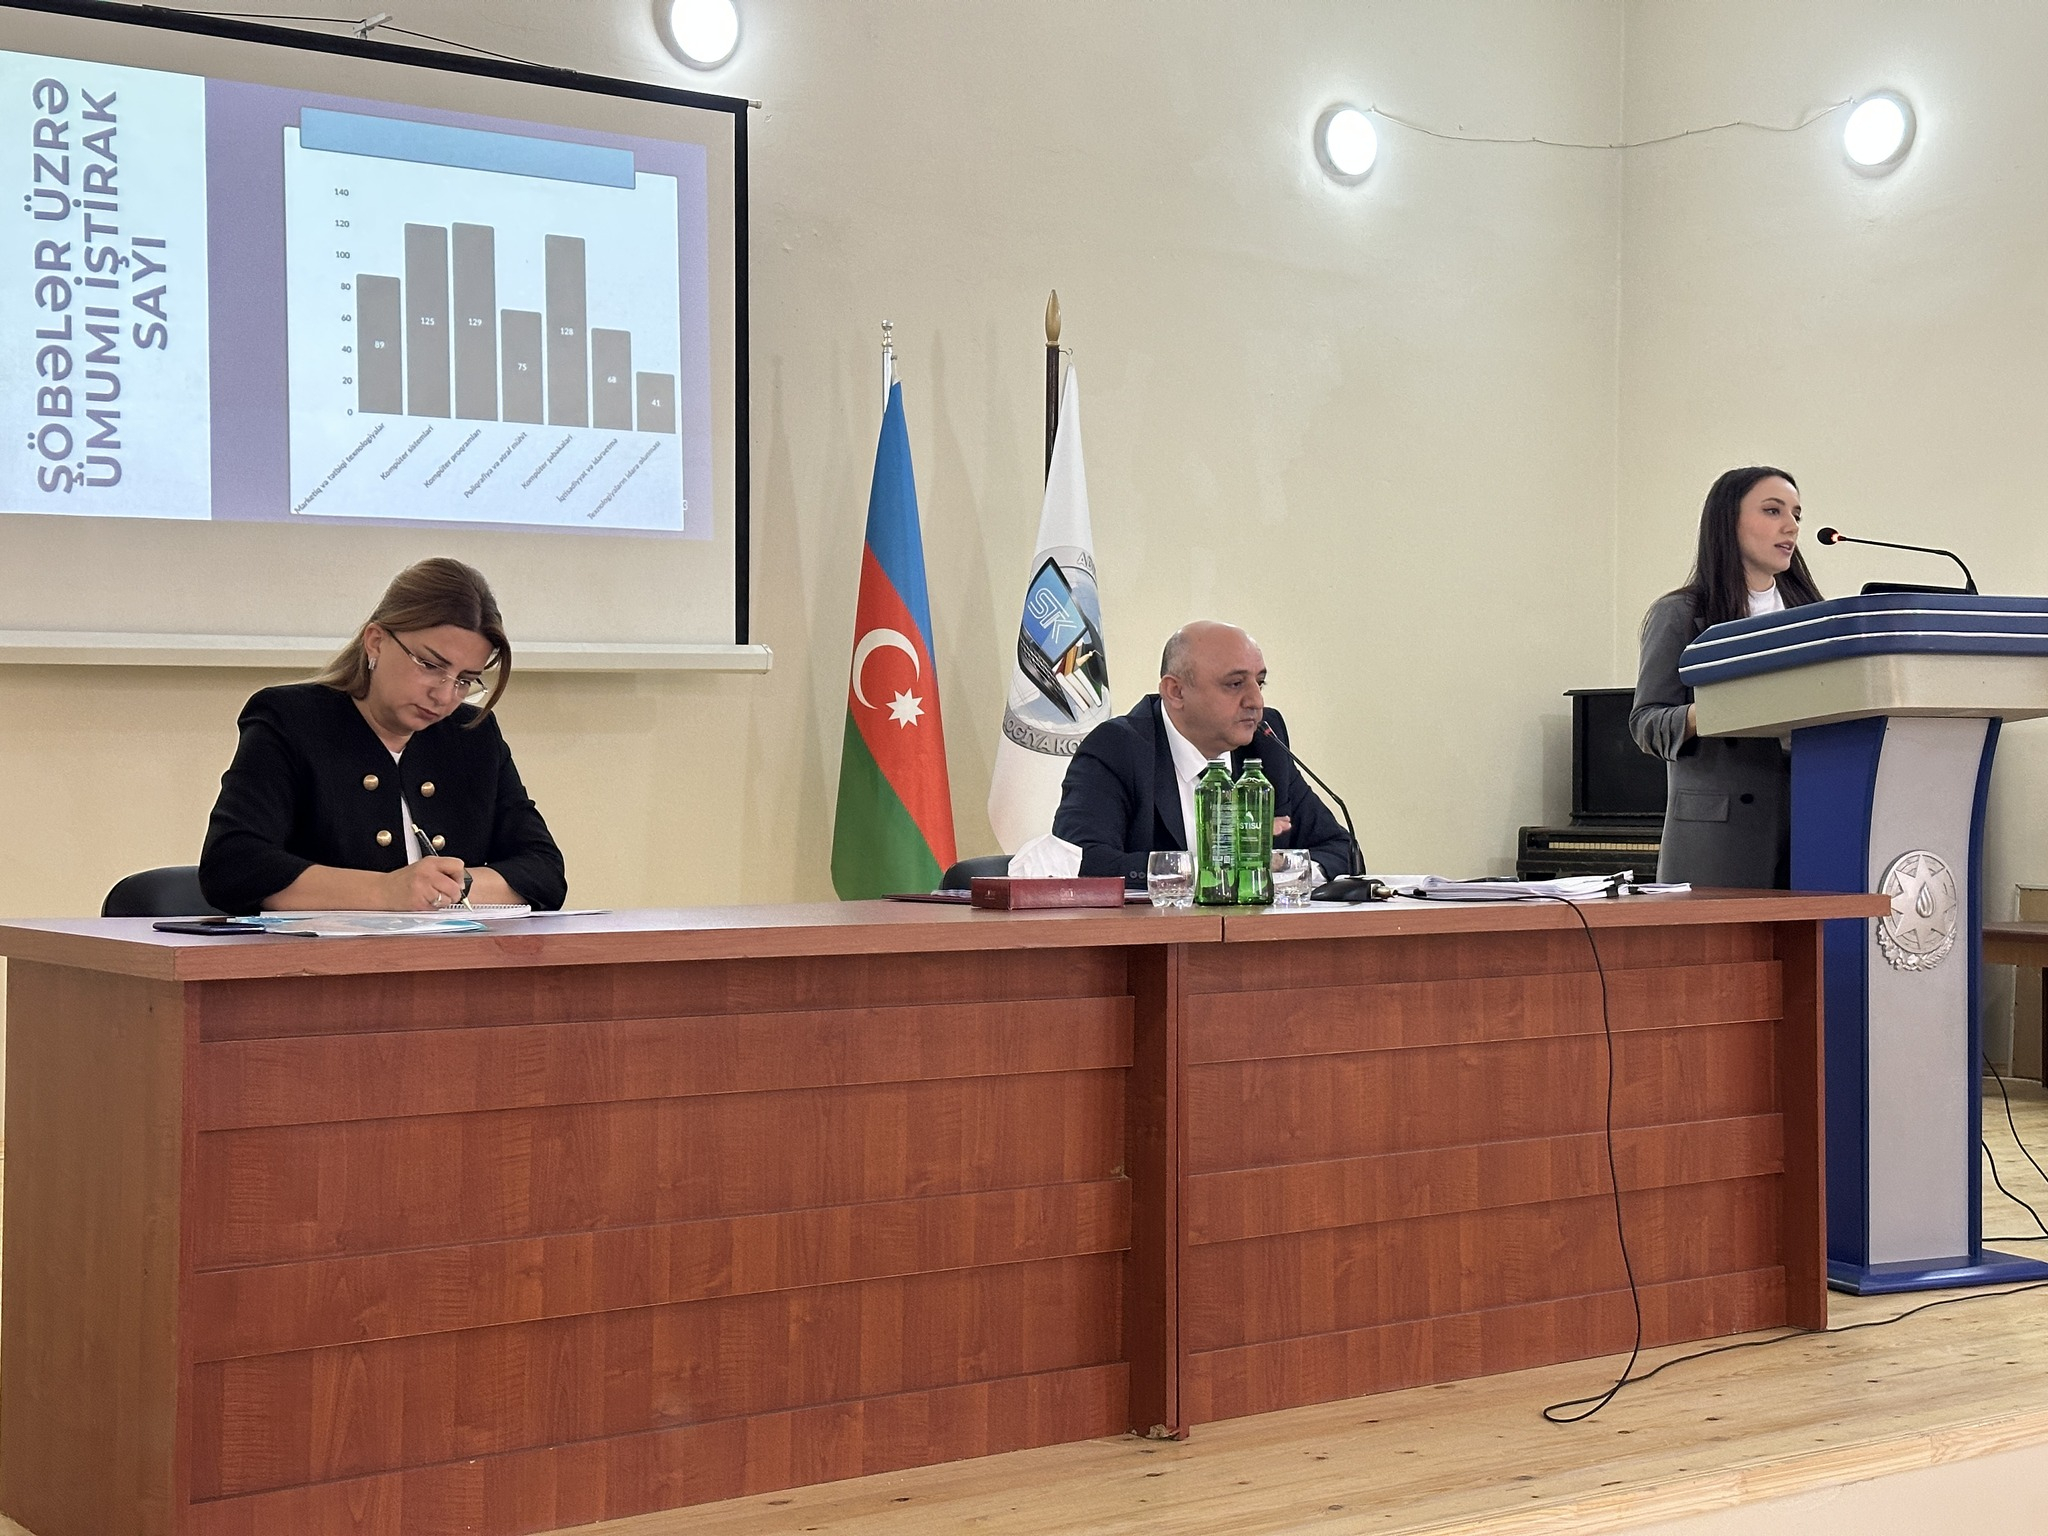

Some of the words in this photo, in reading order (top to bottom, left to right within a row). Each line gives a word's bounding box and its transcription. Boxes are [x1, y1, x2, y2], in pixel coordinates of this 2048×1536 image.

[24, 77, 71, 221] ÜZRƏ
[73, 87, 130, 289] İŞTİRAK
[334, 188, 349, 196] 140
[334, 219, 350, 228] 120
[335, 251, 351, 259] 100
[341, 283, 351, 291] 80
[131, 236, 168, 351] SAYI
[341, 314, 351, 322] 60
[420, 317, 435, 326] 125
[468, 318, 482, 326] 129
[560, 327, 574, 336] 128
[341, 345, 352, 353] 40
[374, 341, 385, 349] 89
[27, 239, 84, 494] ŞÖBƏLƏR
[517, 363, 527, 371] 75
[651, 399, 661, 407] 41
[346, 408, 353, 416] 0
[294, 486, 323, 514] Marketiq
[1004, 719, 1051, 753] OGİYA
